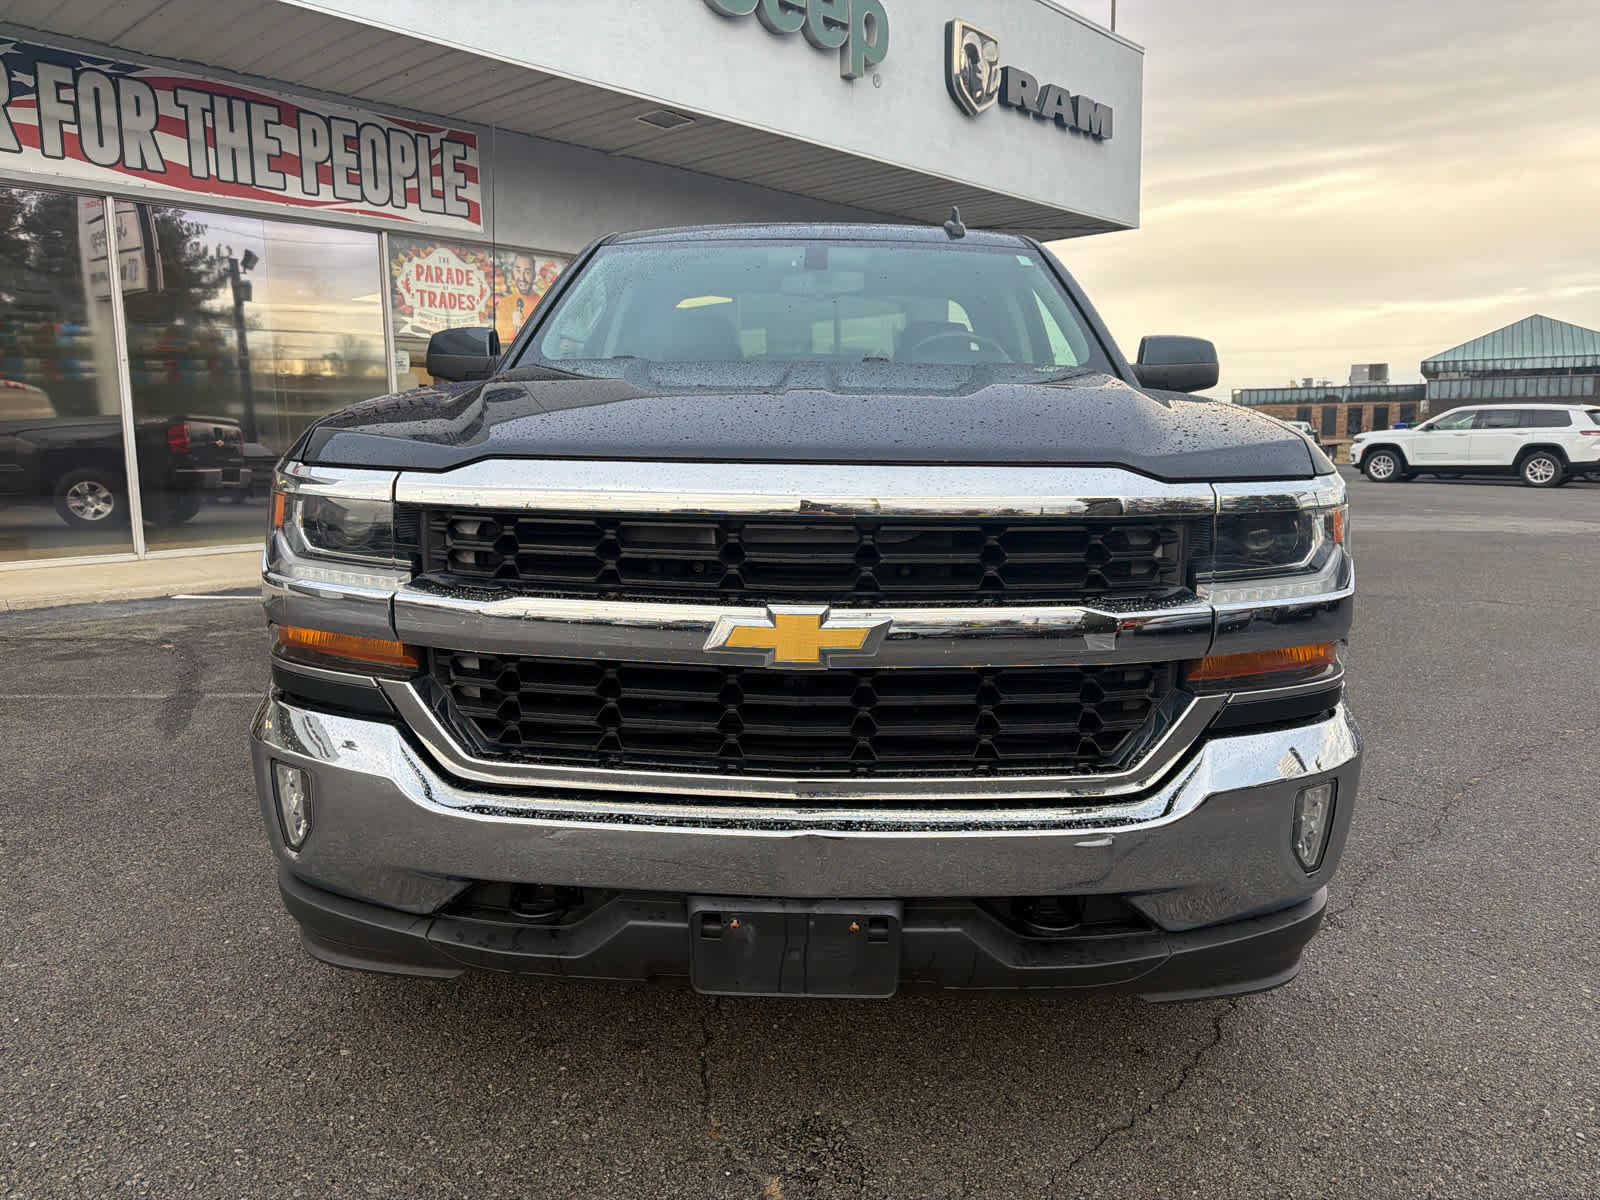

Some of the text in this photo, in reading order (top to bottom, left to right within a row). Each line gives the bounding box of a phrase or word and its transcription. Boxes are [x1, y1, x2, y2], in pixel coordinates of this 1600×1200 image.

[703, 0, 889, 80] eep
[34, 60, 167, 174] FOR
[174, 86, 287, 191] THE
[297, 109, 471, 218] PEOPLE
[1000, 66, 1113, 140] RAM
[415, 263, 474, 287] PARADE
[415, 288, 476, 312] TRADES
